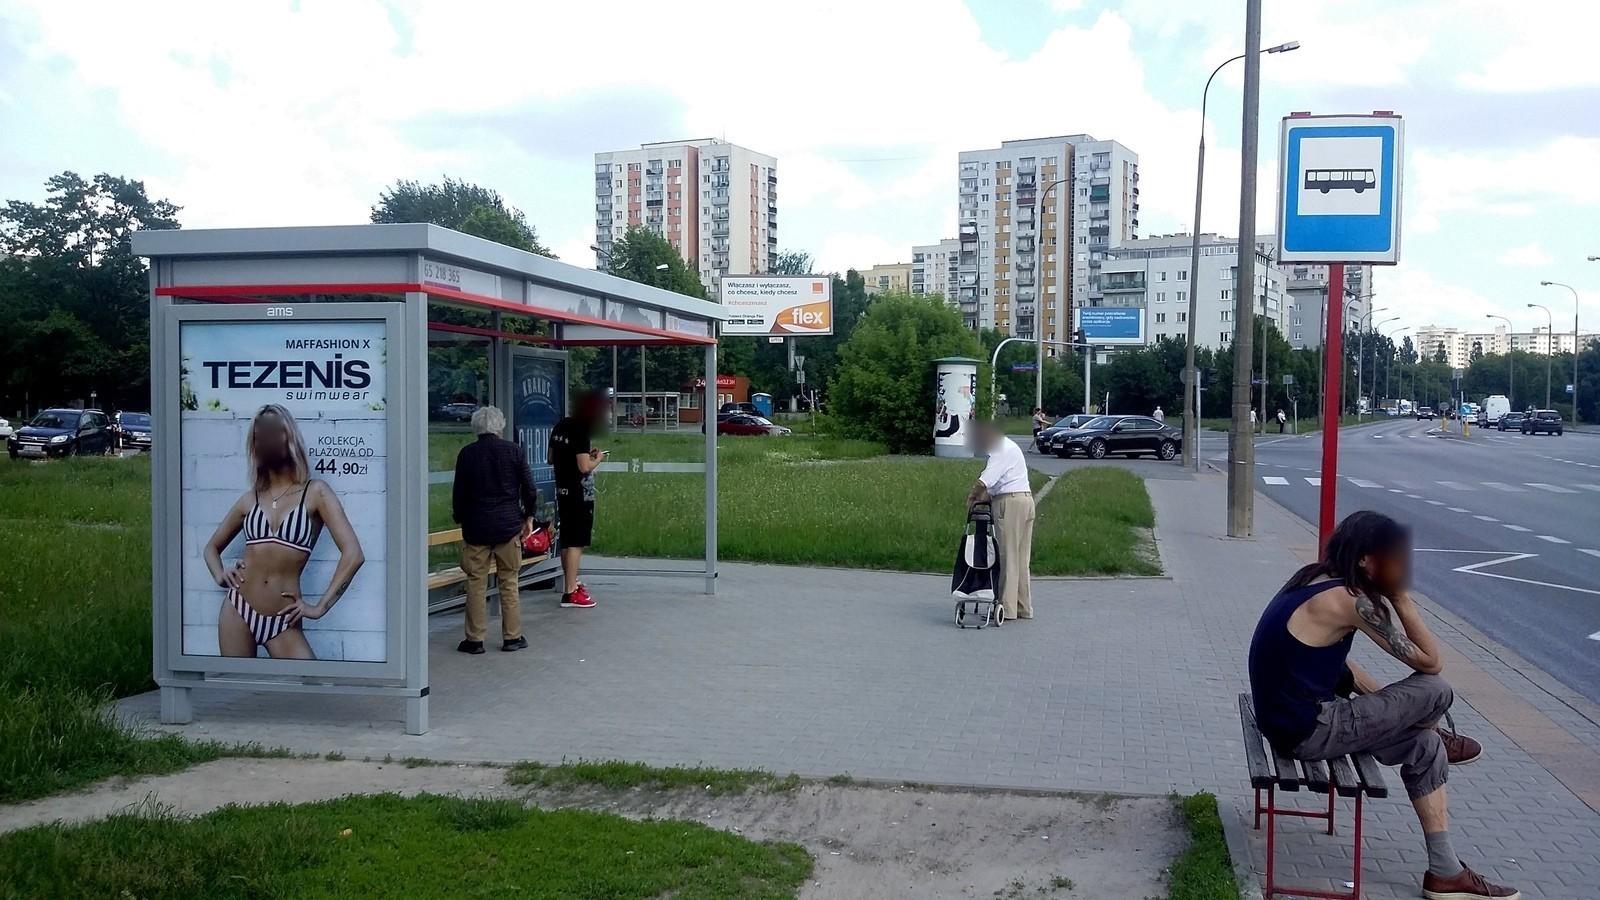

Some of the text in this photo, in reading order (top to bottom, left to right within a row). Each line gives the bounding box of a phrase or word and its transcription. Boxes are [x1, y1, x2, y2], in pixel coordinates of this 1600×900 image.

[266, 307, 294, 317] ams
[791, 308, 824, 324] flex
[285, 339, 371, 350] MAFFASHION X
[286, 390, 370, 400] swimwear
[318, 436, 365, 447] KOLEKCJA
[518, 427, 554, 465] CHRU
[309, 446, 374, 457] PLAŻOWA OD
